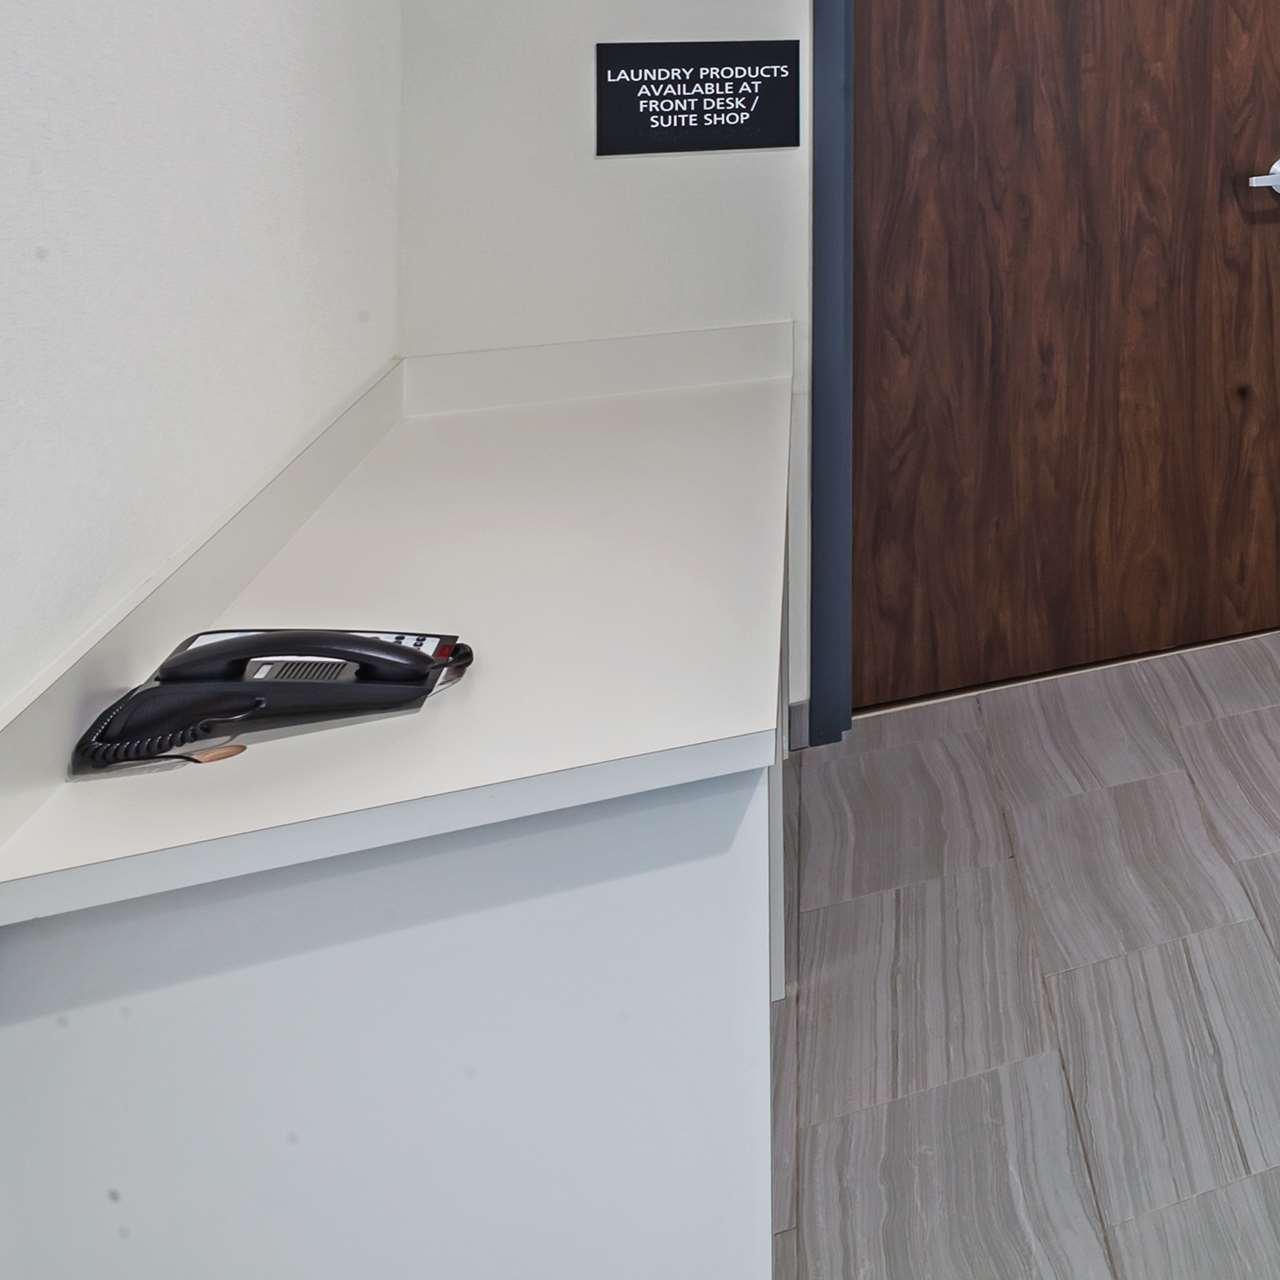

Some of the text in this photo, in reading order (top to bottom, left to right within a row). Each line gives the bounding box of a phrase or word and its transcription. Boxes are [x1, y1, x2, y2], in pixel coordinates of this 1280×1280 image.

[607, 65, 789, 82] LAUNDRY PRODUCTS
[637, 81, 762, 97] AVAILABLE AT
[639, 96, 759, 112] FRONT DESK /
[650, 112, 750, 128] SUITE SHOP
